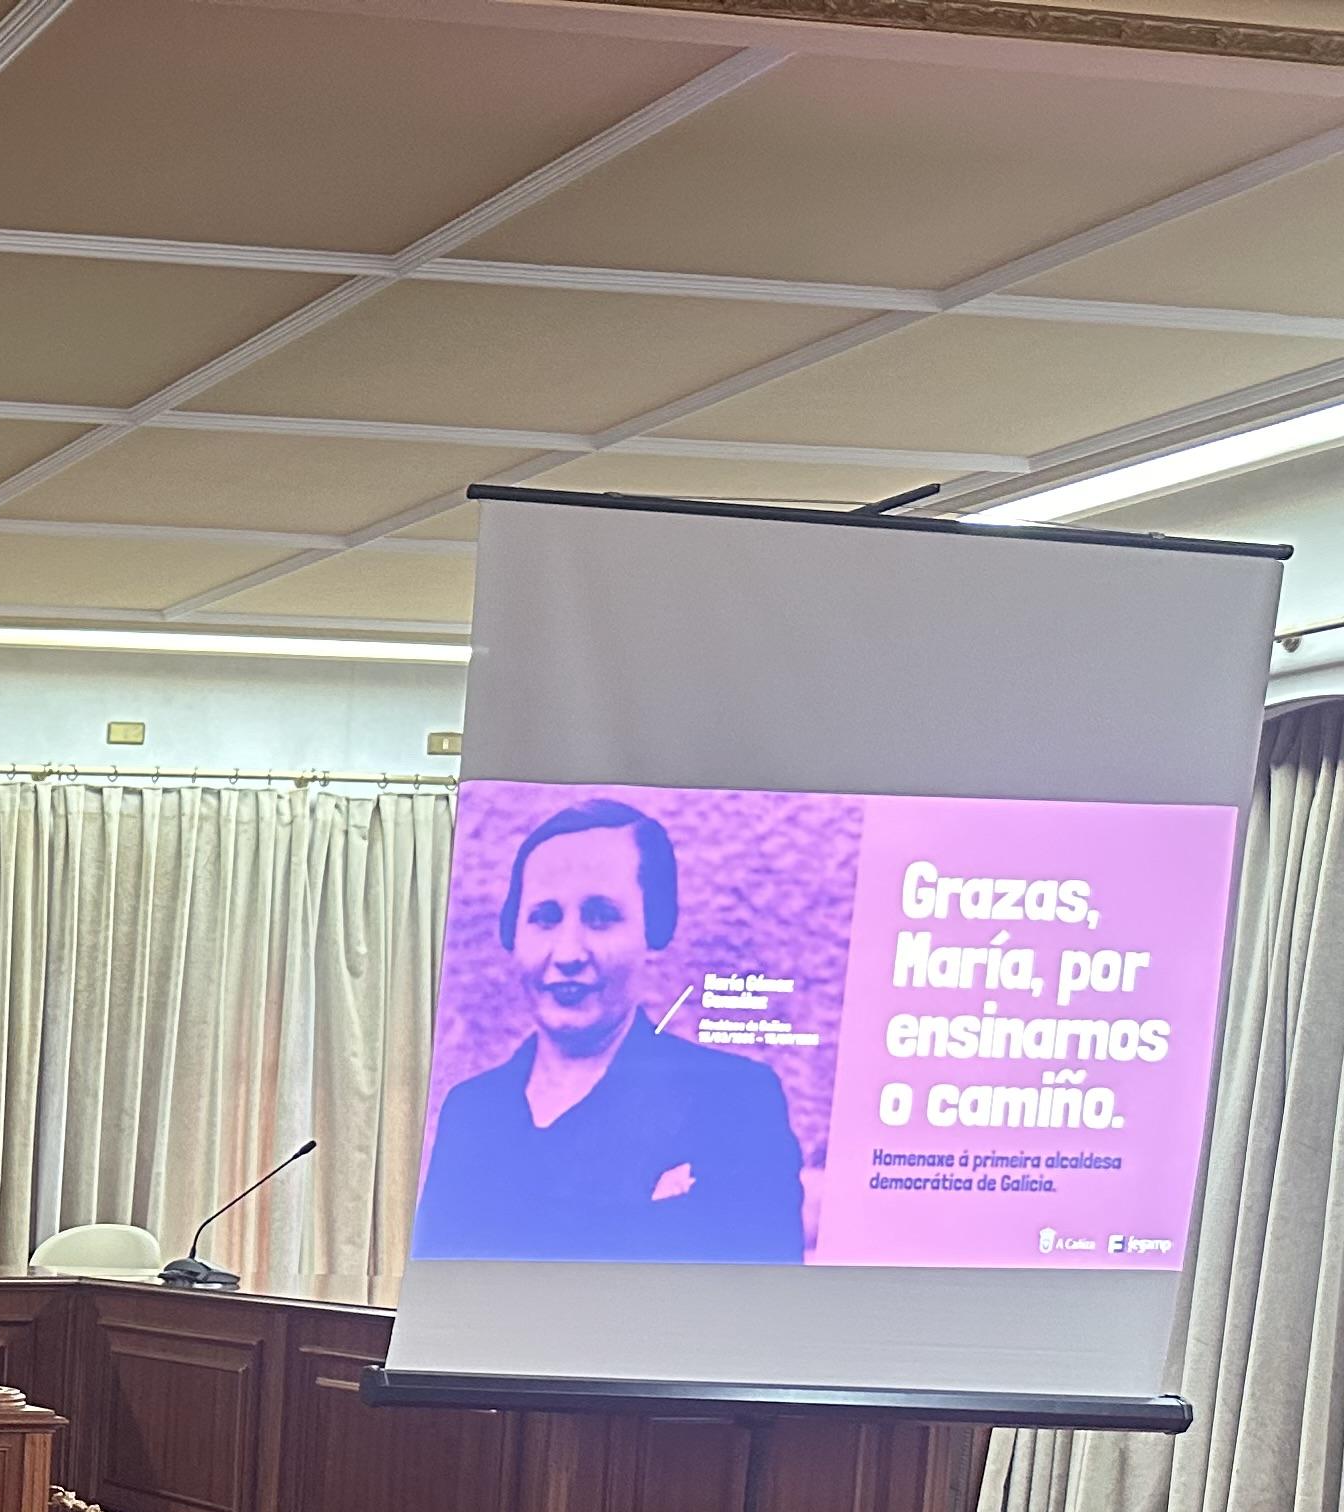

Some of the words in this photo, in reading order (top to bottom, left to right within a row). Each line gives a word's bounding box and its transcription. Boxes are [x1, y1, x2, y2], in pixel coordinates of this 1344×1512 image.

[902, 860, 1100, 929] Grazas,
[892, 930, 1044, 997] María,
[1056, 949, 1151, 1006] por
[887, 1001, 1171, 1062] ensinarnos
[879, 1082, 912, 1126] o
[926, 1069, 1125, 1129] camiño.
[869, 1172, 973, 1191] democrática
[977, 1174, 997, 1191] de
[1000, 1174, 1057, 1192] Galicia.
[872, 1149, 955, 1168] Homenaxe
[972, 1150, 1041, 1172] primeira
[1045, 1151, 1122, 1170] alcaldesa
